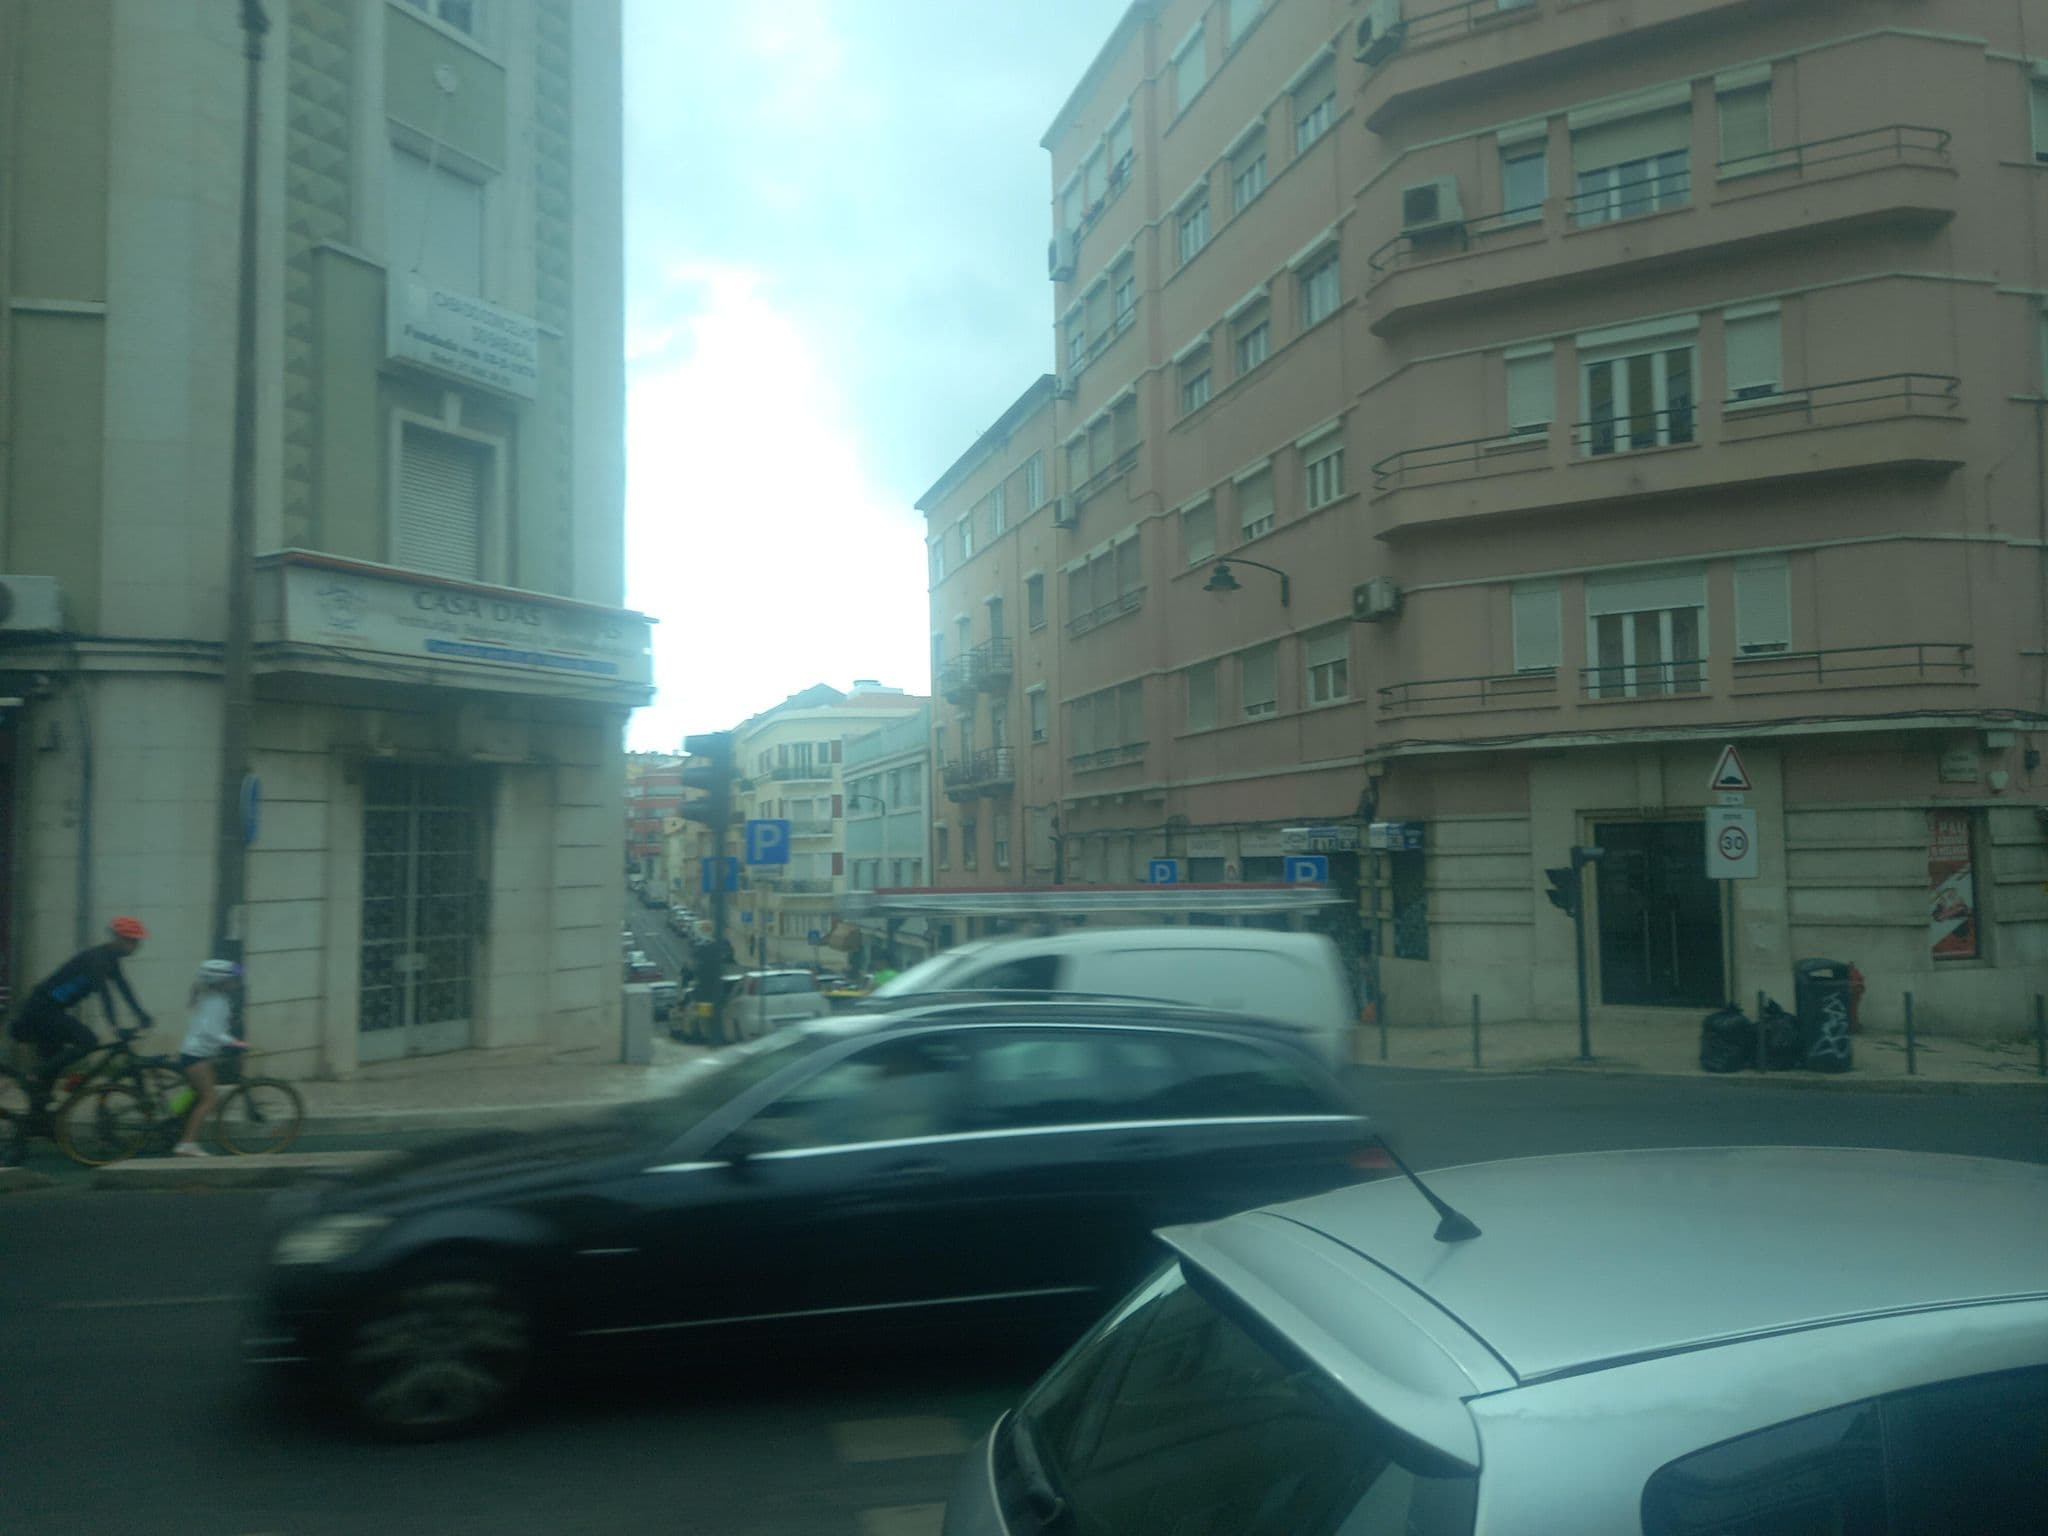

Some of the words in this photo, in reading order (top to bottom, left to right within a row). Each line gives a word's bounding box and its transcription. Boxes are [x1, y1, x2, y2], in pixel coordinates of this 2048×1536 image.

[414, 591, 482, 618] CASA
[493, 603, 541, 626] DAS
[753, 823, 783, 861] P
[1723, 835, 1745, 851] 30
[1155, 864, 1171, 883] P
